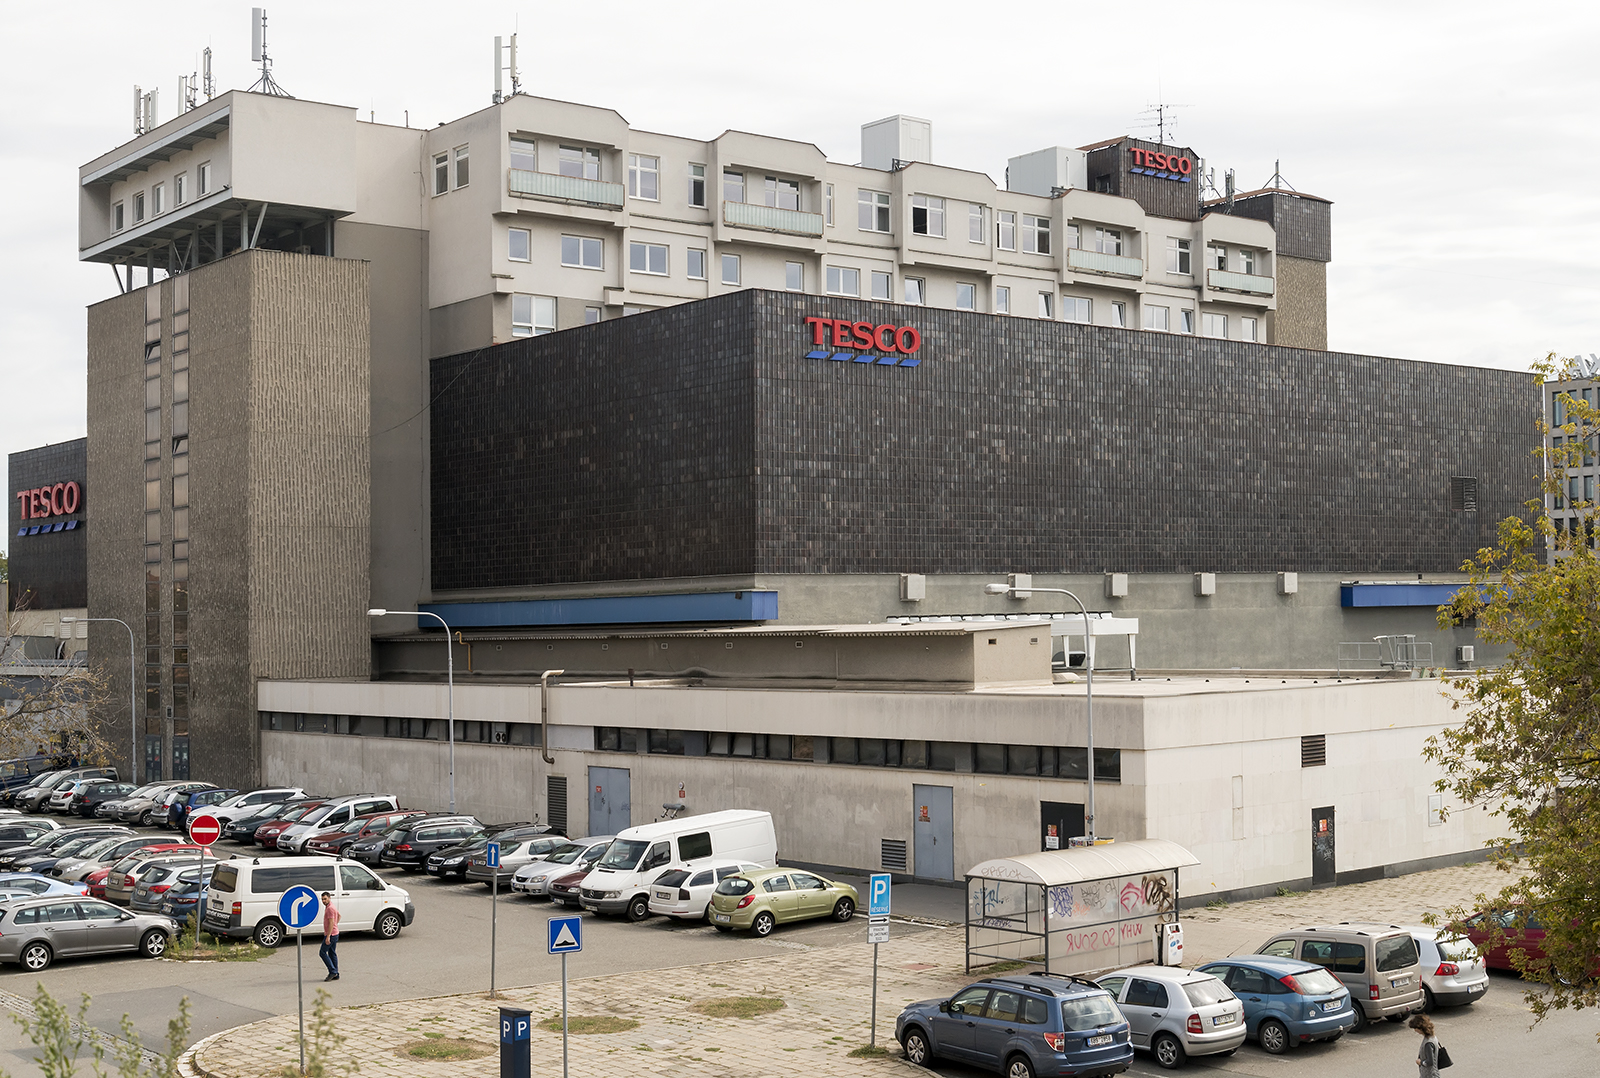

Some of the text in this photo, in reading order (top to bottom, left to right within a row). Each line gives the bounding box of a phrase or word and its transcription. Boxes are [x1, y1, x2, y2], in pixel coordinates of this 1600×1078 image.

[1129, 147, 1192, 174] TESCO
[803, 316, 921, 354] TESCO
[17, 481, 80, 520] TESCO
[874, 880, 887, 903] P
[504, 1020, 510, 1038] P
[518, 1021, 527, 1036] P
